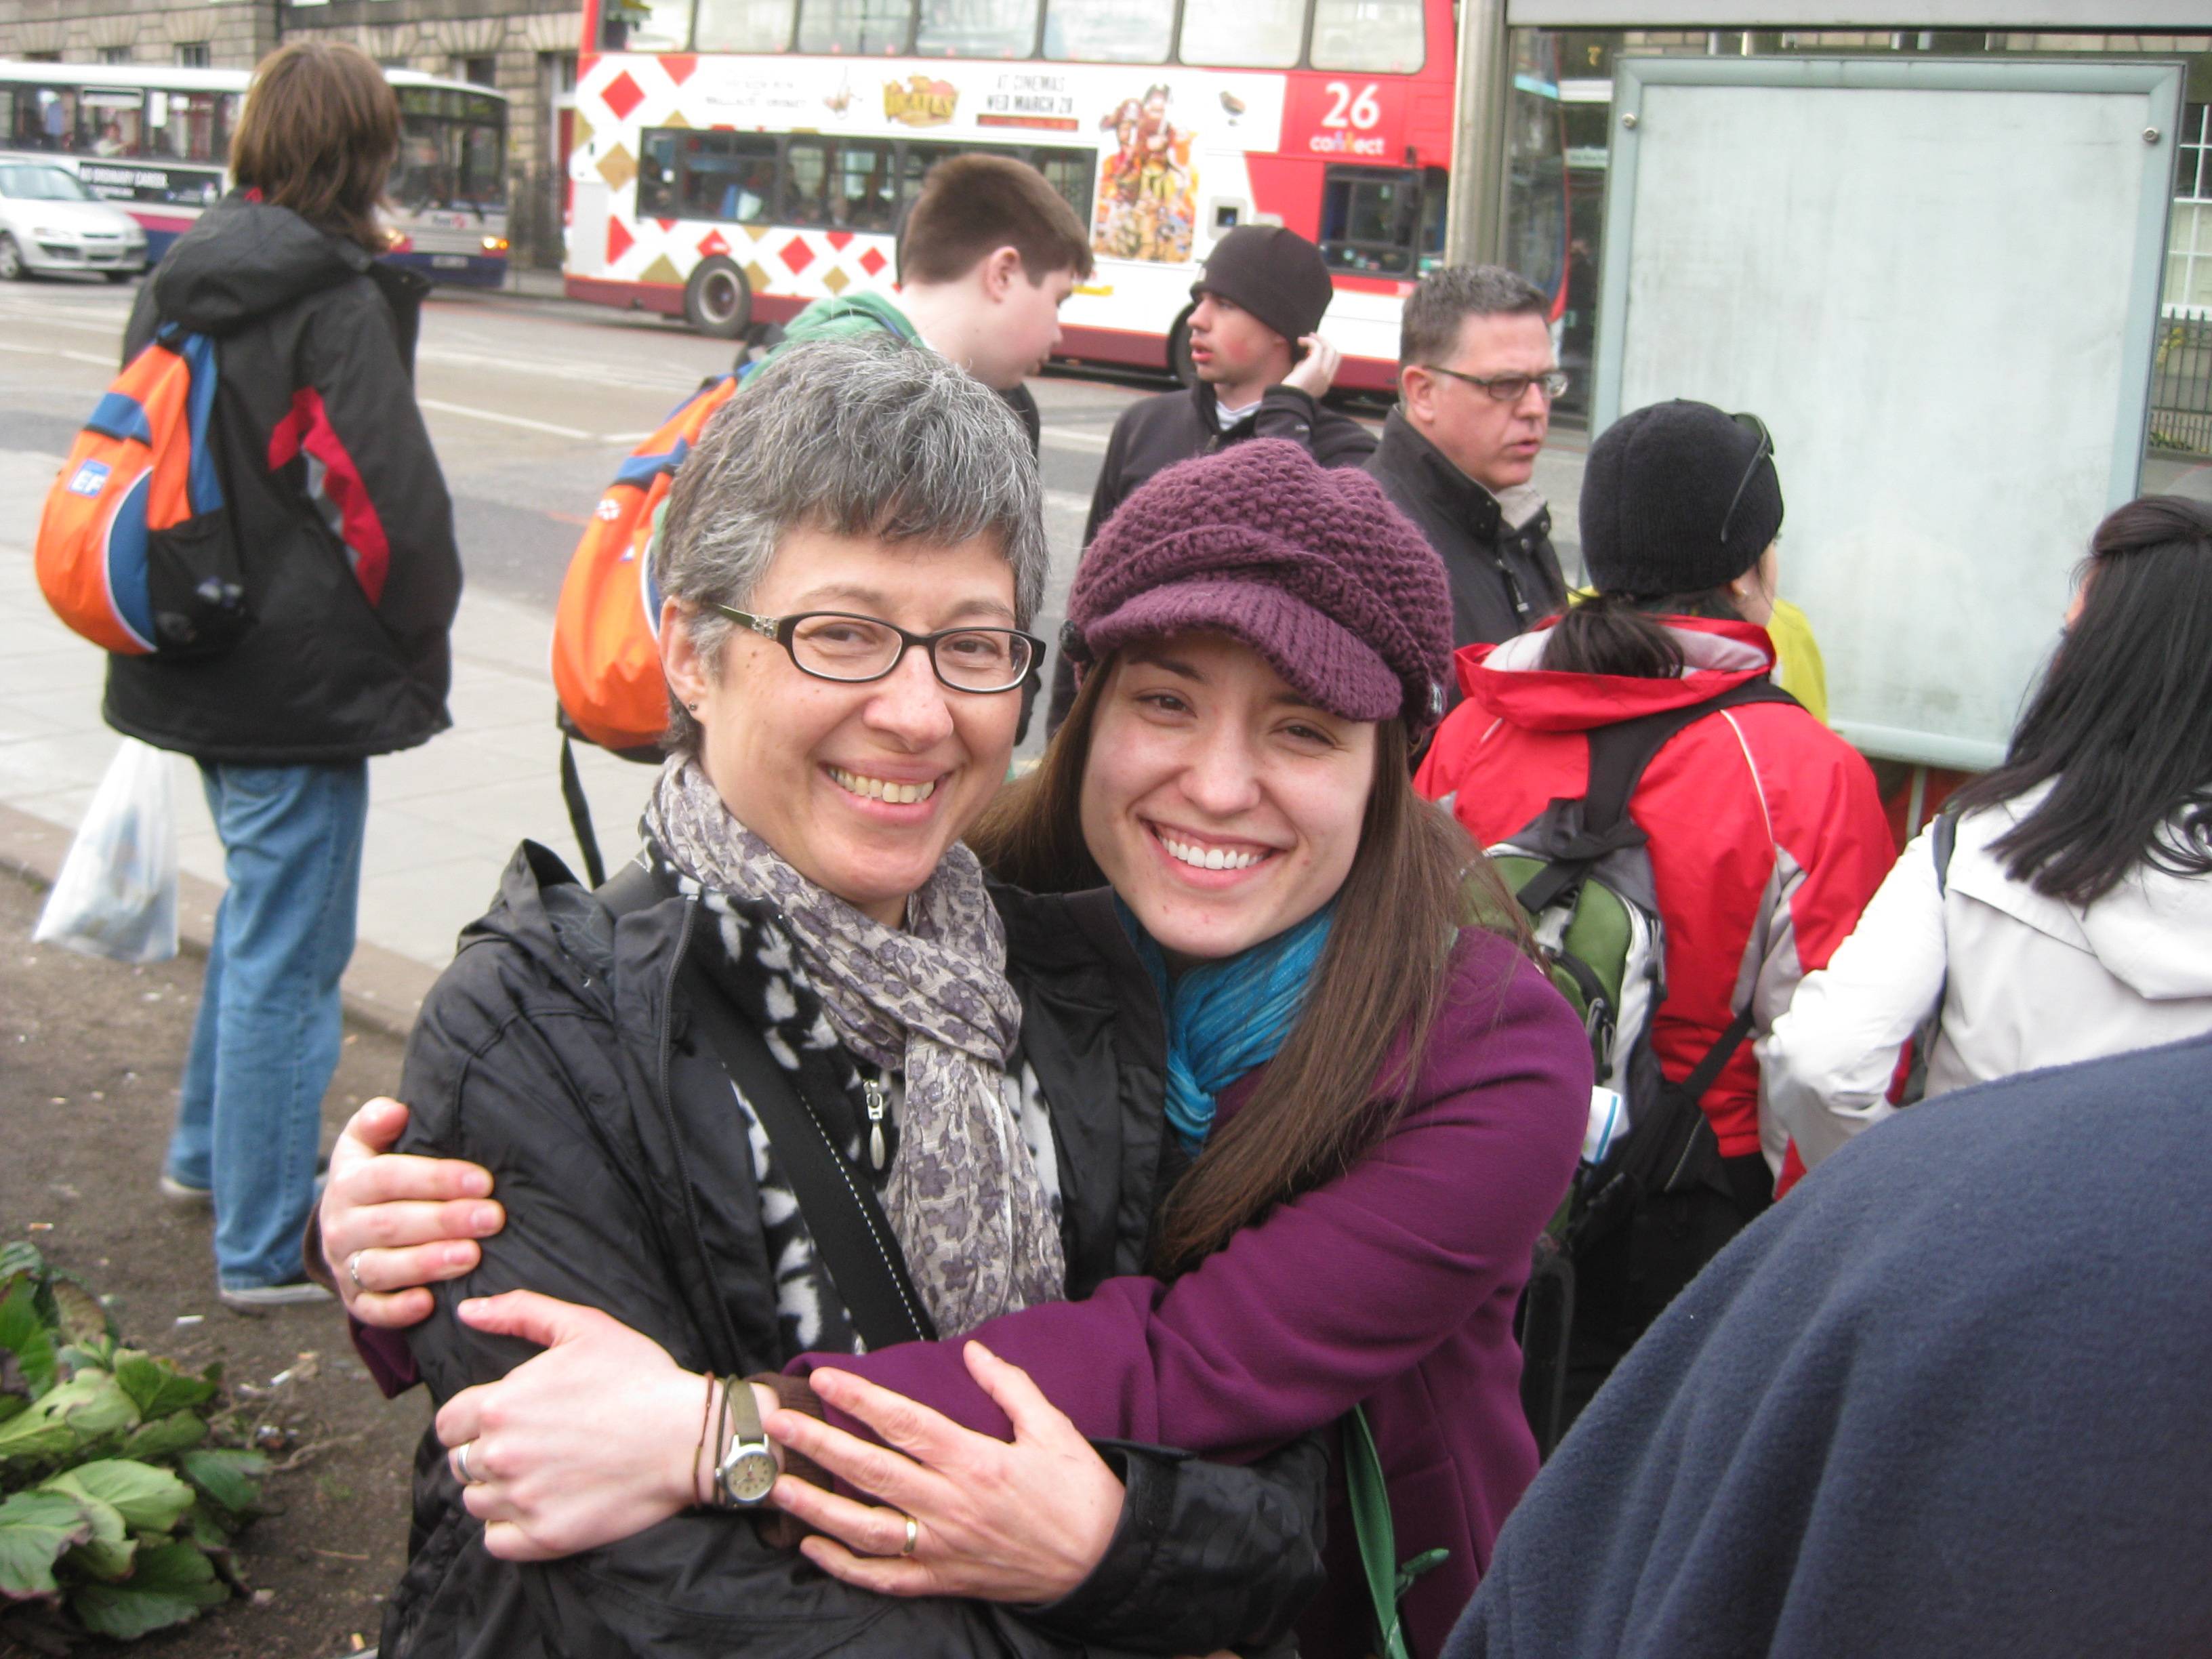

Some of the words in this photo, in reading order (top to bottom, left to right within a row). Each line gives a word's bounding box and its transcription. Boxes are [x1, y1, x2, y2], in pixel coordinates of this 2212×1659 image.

[1015, 96, 1054, 112] MARCH
[1322, 82, 1380, 129] 26
[70, 469, 105, 493] EF
